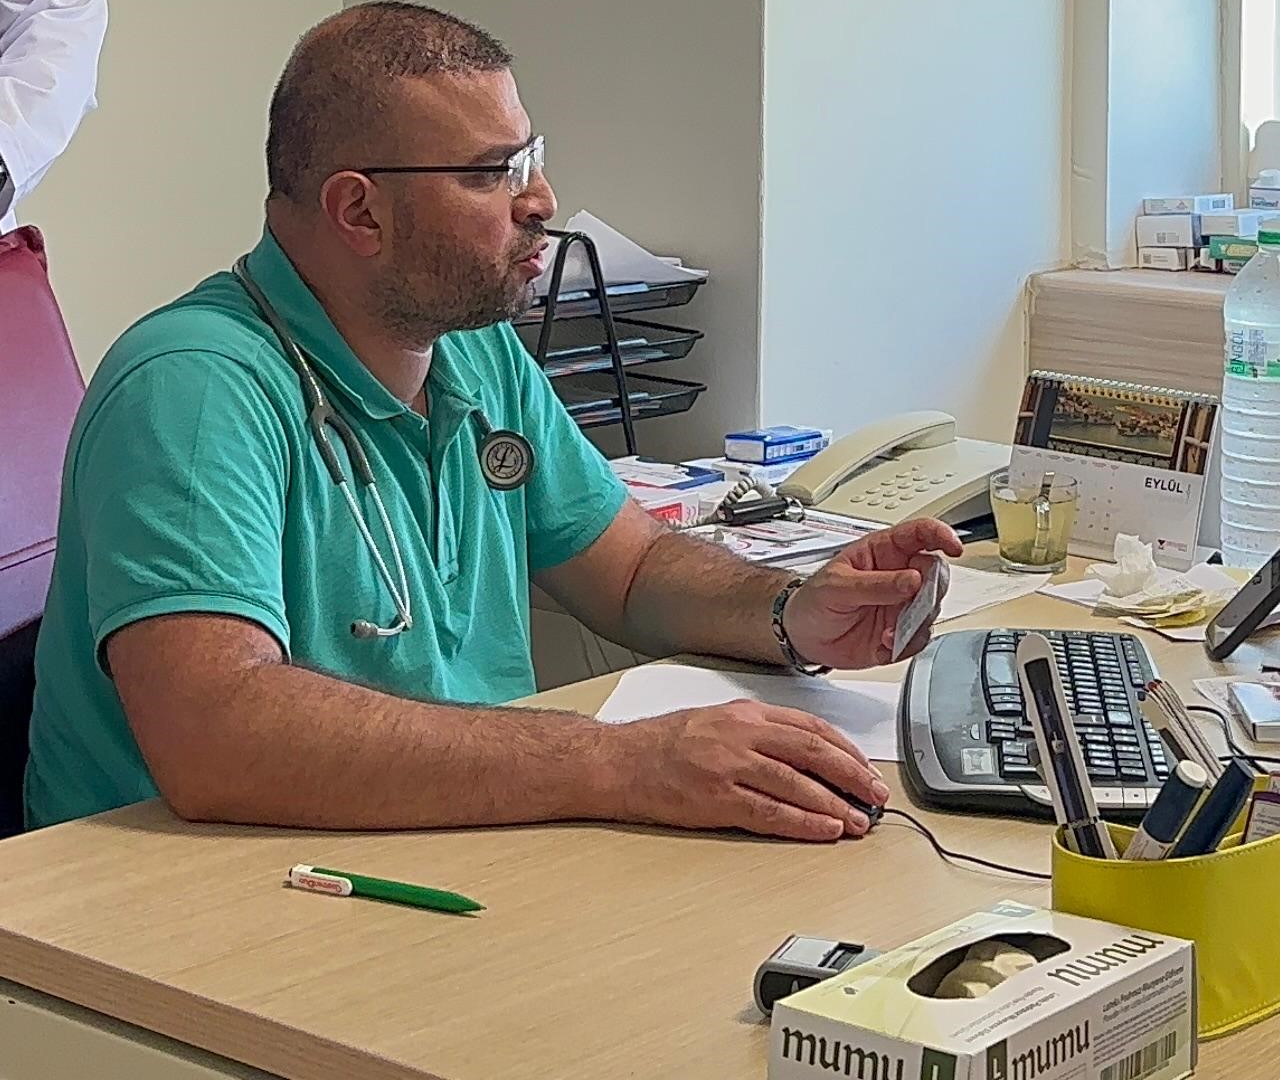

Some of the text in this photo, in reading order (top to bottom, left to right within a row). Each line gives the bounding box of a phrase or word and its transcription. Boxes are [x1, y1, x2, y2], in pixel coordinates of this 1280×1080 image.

[1144, 476, 1184, 494] EYLÜL
[781, 1025, 905, 1080] mumu
[1012, 1019, 1090, 1080] mumu
